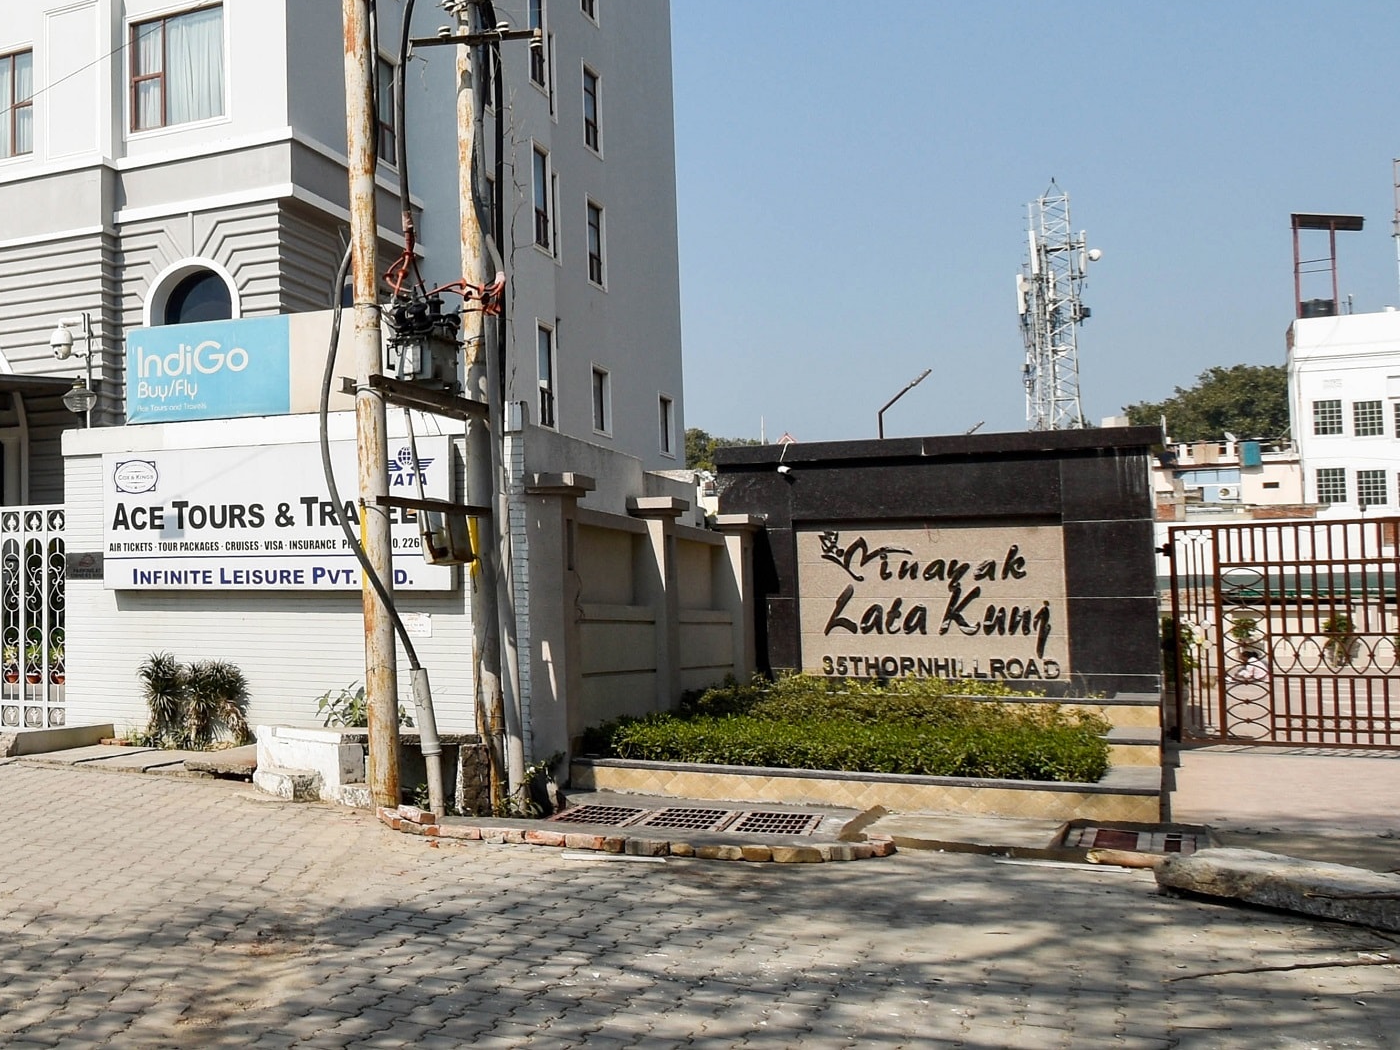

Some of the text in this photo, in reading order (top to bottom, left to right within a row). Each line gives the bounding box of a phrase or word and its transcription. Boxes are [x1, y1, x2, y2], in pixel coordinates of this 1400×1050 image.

[137, 340, 249, 378] IndiGo
[112, 502, 165, 530] ACE
[171, 500, 265, 529] TOURS
[274, 502, 296, 528] &
[109, 542, 121, 552] AIR
[123, 542, 153, 552] TICKETS
[158, 541, 178, 551] TOUR
[179, 541, 219, 551] PACKAGES
[225, 540, 259, 551] CRUISES
[264, 540, 284, 550] VISA
[289, 539, 337, 550] INSURANCE
[133, 568, 213, 585] INFINITE
[220, 567, 305, 585] LEISURE
[312, 566, 358, 585] PVT.
[824, 584, 1052, 659] Lata Kunj
